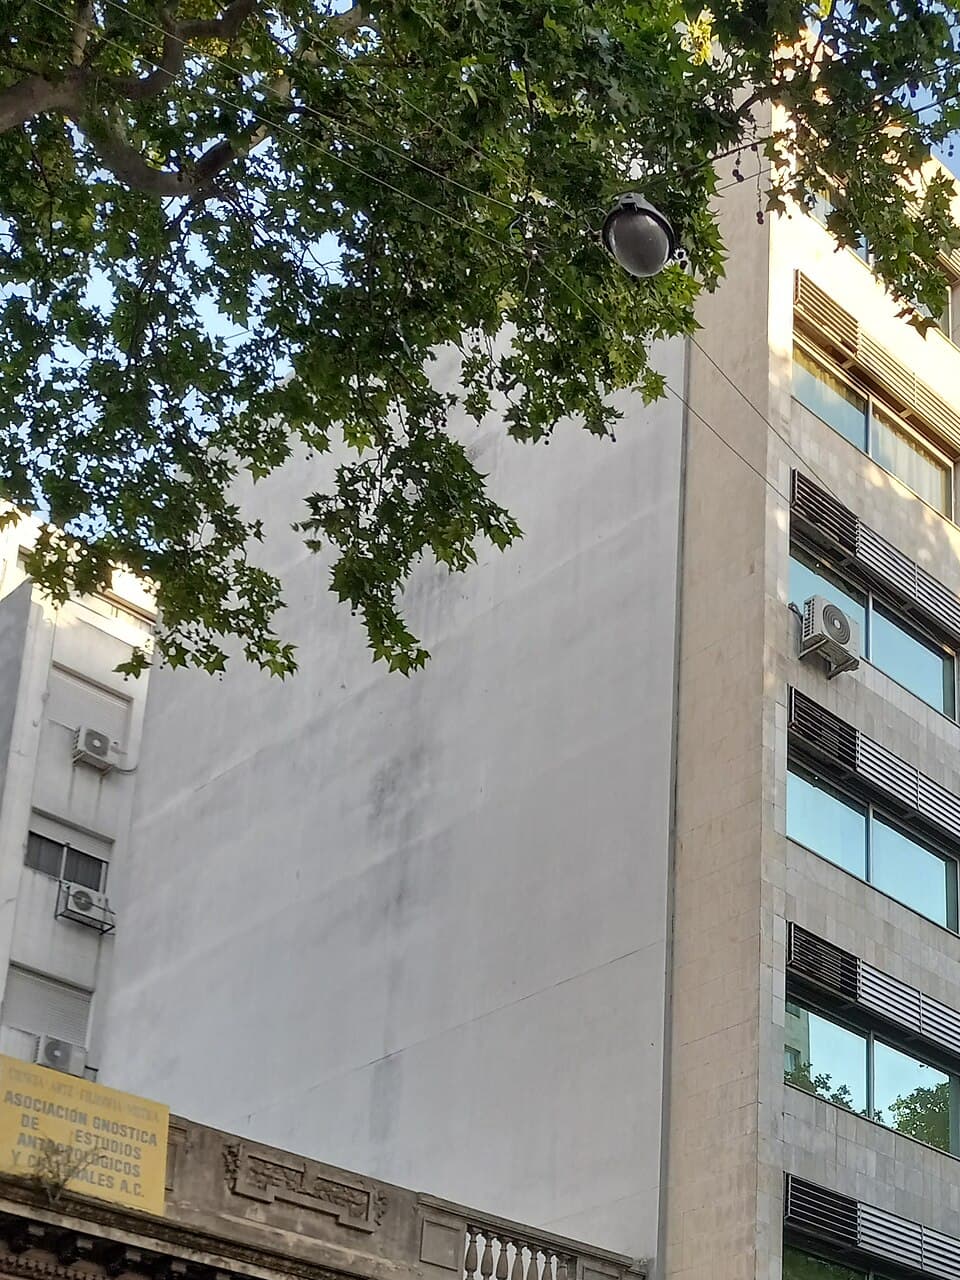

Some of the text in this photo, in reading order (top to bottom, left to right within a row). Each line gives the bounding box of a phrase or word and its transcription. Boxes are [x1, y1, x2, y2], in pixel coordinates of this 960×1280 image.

[21, 1113, 142, 1160] DE ESTUDIOS
[11, 1149, 21, 1168] Y
